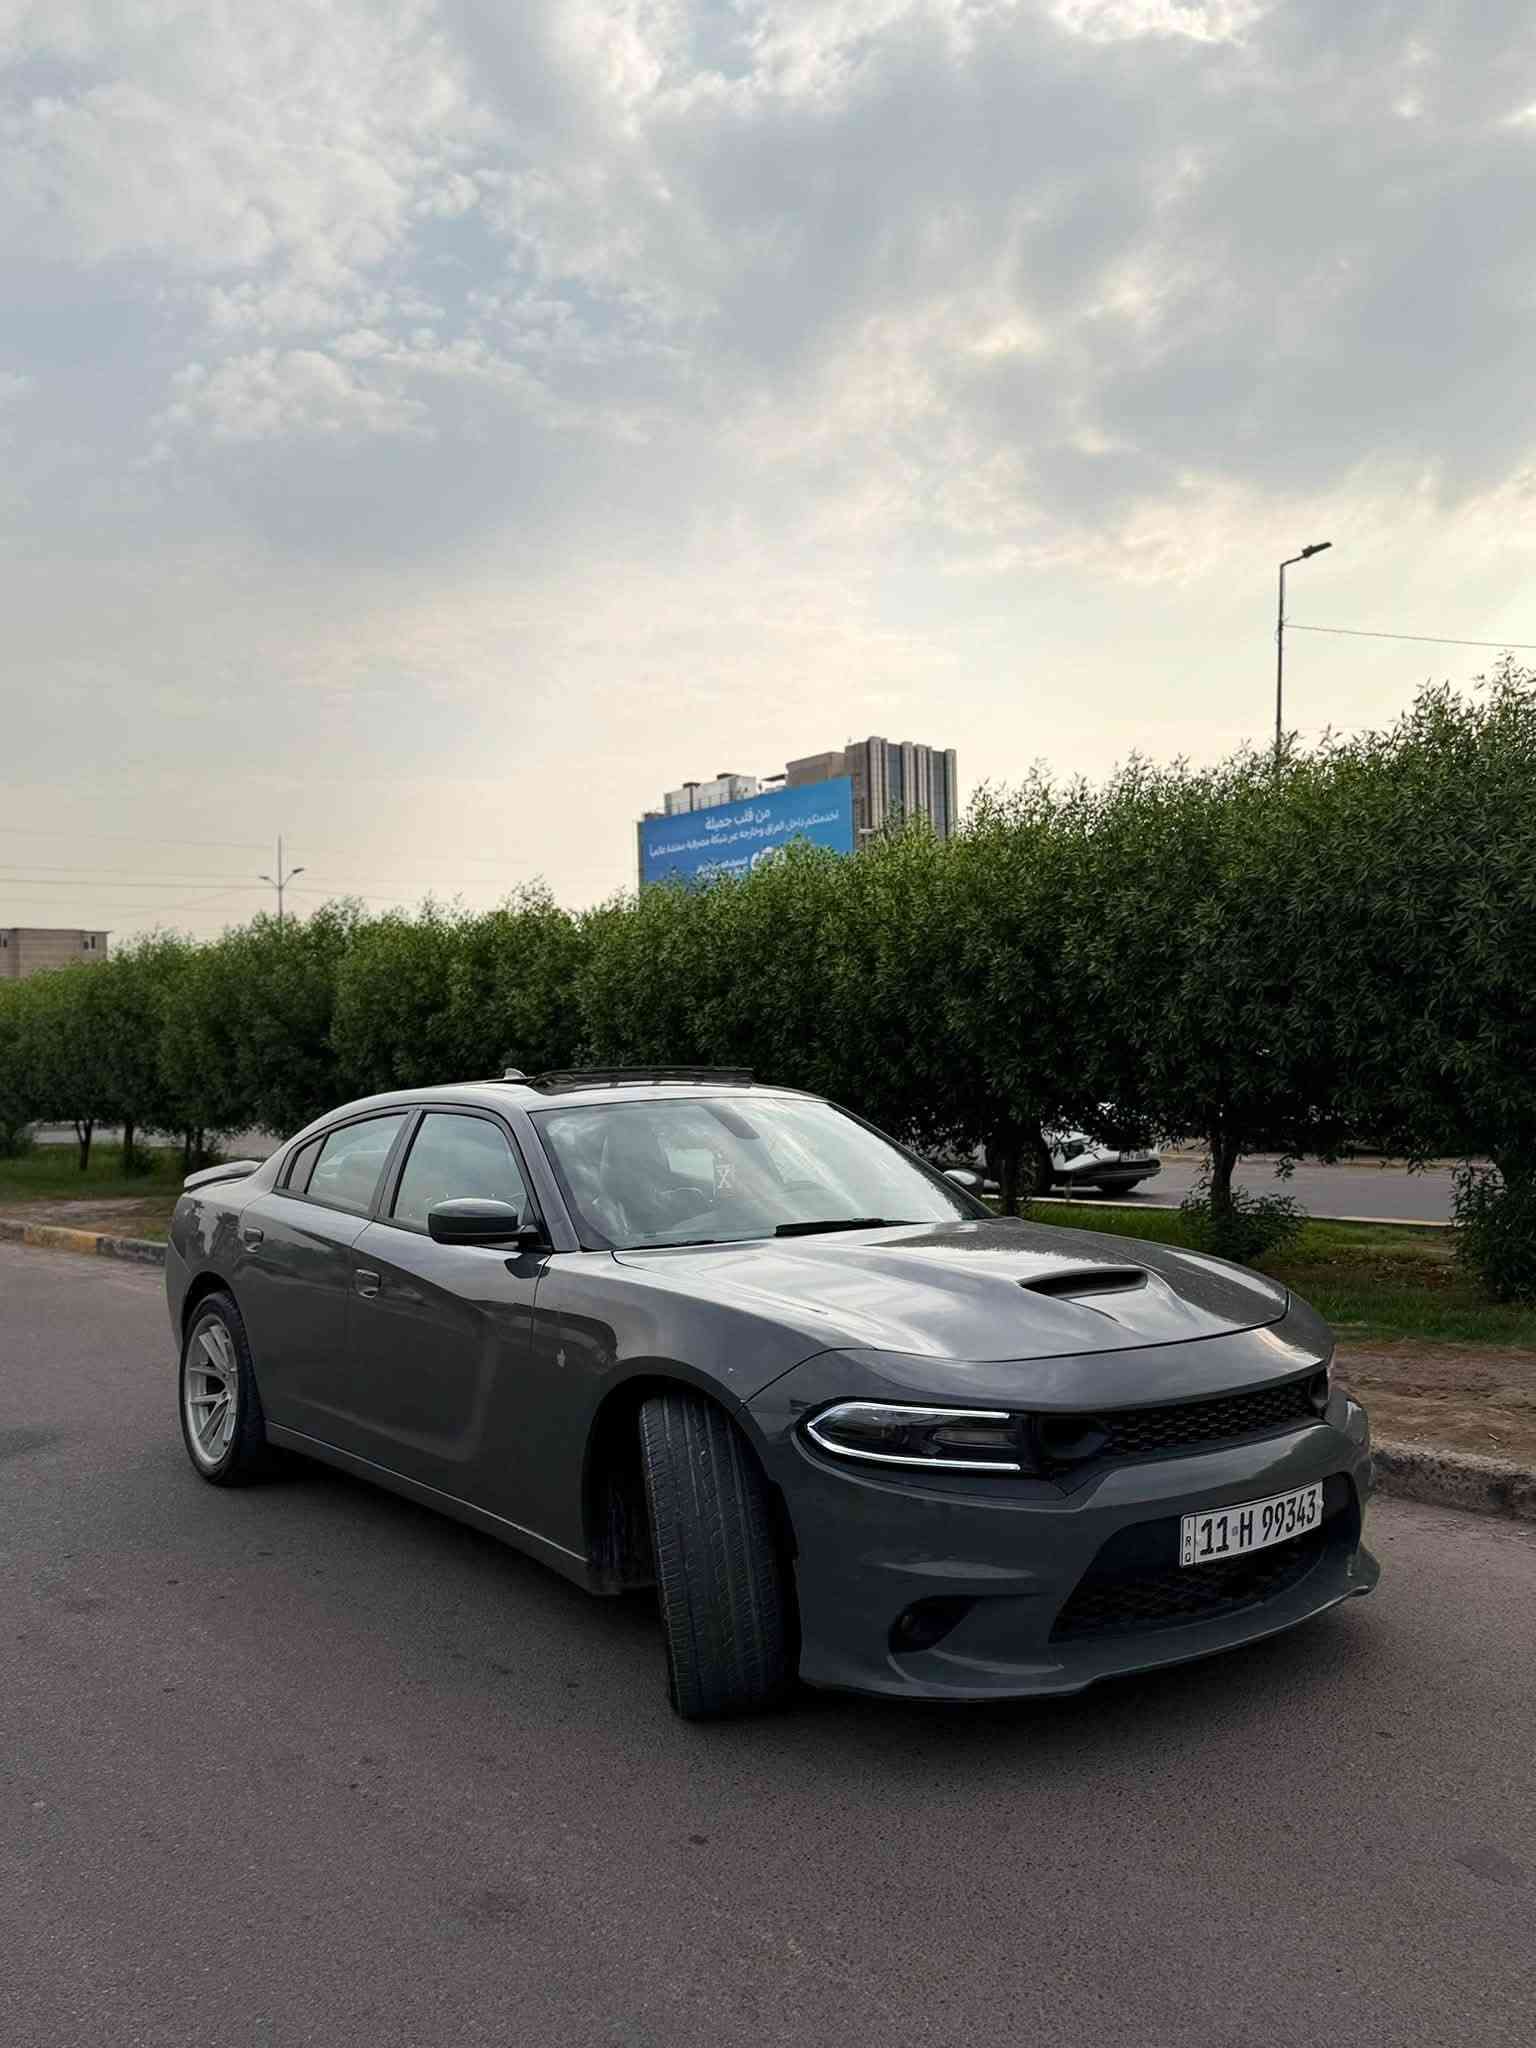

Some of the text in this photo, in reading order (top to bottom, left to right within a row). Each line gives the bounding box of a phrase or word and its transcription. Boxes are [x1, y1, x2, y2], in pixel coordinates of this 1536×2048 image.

[735, 807, 754, 826] قلب
[755, 809, 771, 823] من
[1200, 1516, 1230, 1556] 11
[1239, 1510, 1254, 1548] H
[1262, 1489, 1317, 1542] 99343
